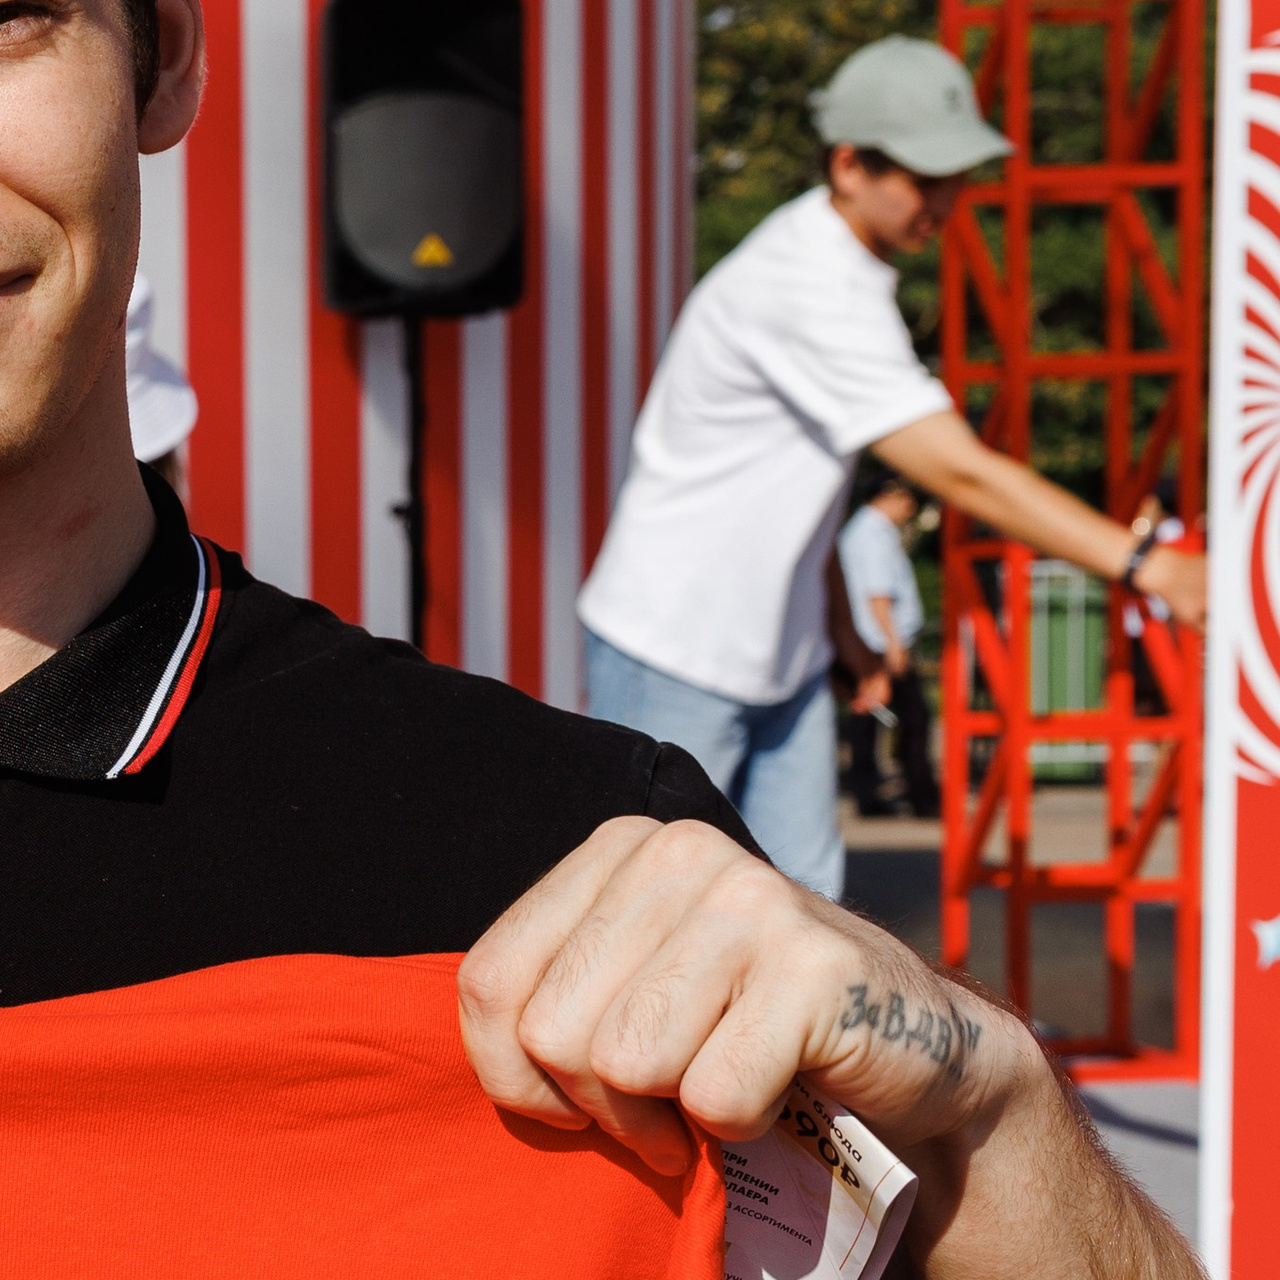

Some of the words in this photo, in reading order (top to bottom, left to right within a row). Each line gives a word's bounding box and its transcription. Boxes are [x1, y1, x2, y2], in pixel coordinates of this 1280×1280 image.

[813, 1100, 863, 1163] блюда
[722, 1149, 748, 1167] ПРИ
[723, 1165, 780, 1196] ВЛЕНИИ
[733, 1204, 812, 1246] АССОРТИМЕНТА
